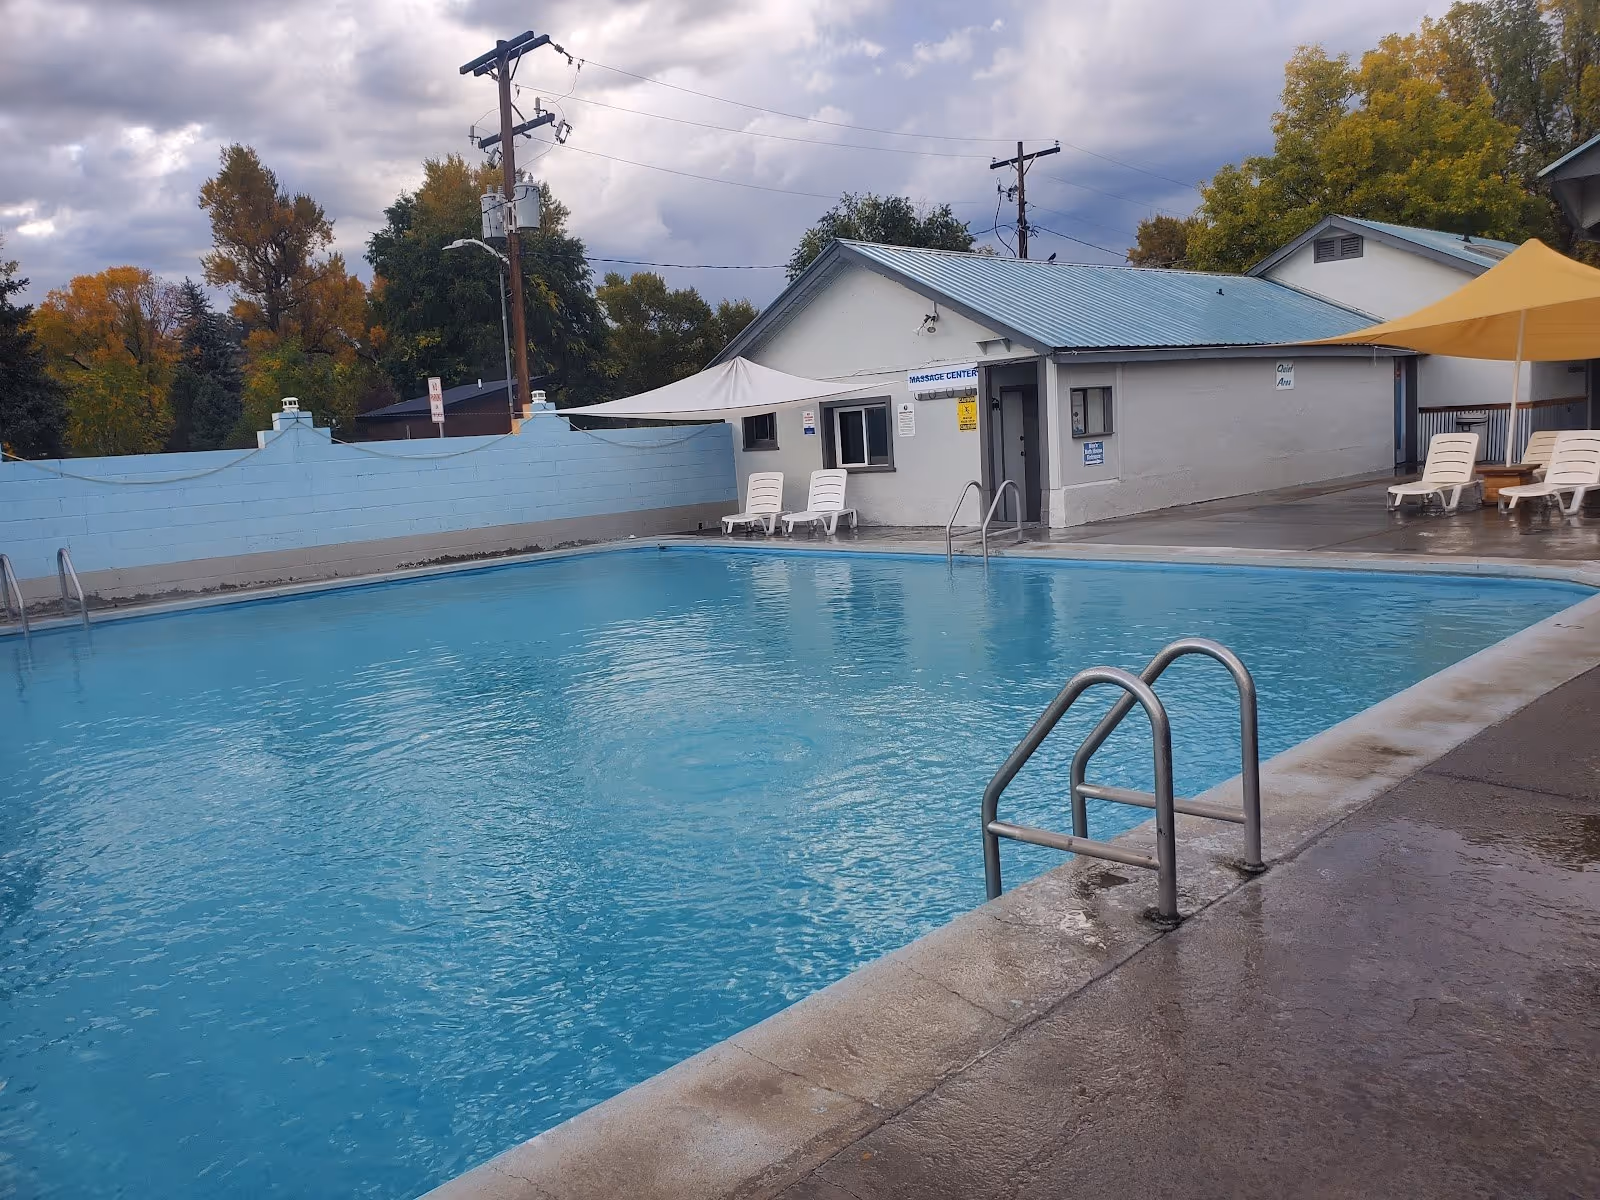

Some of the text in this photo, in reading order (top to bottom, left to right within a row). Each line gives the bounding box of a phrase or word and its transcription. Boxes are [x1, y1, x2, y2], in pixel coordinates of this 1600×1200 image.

[1277, 364, 1293, 373] Quiet
[909, 369, 978, 383] MASSAGE CENTER
[1276, 377, 1291, 386] Area
